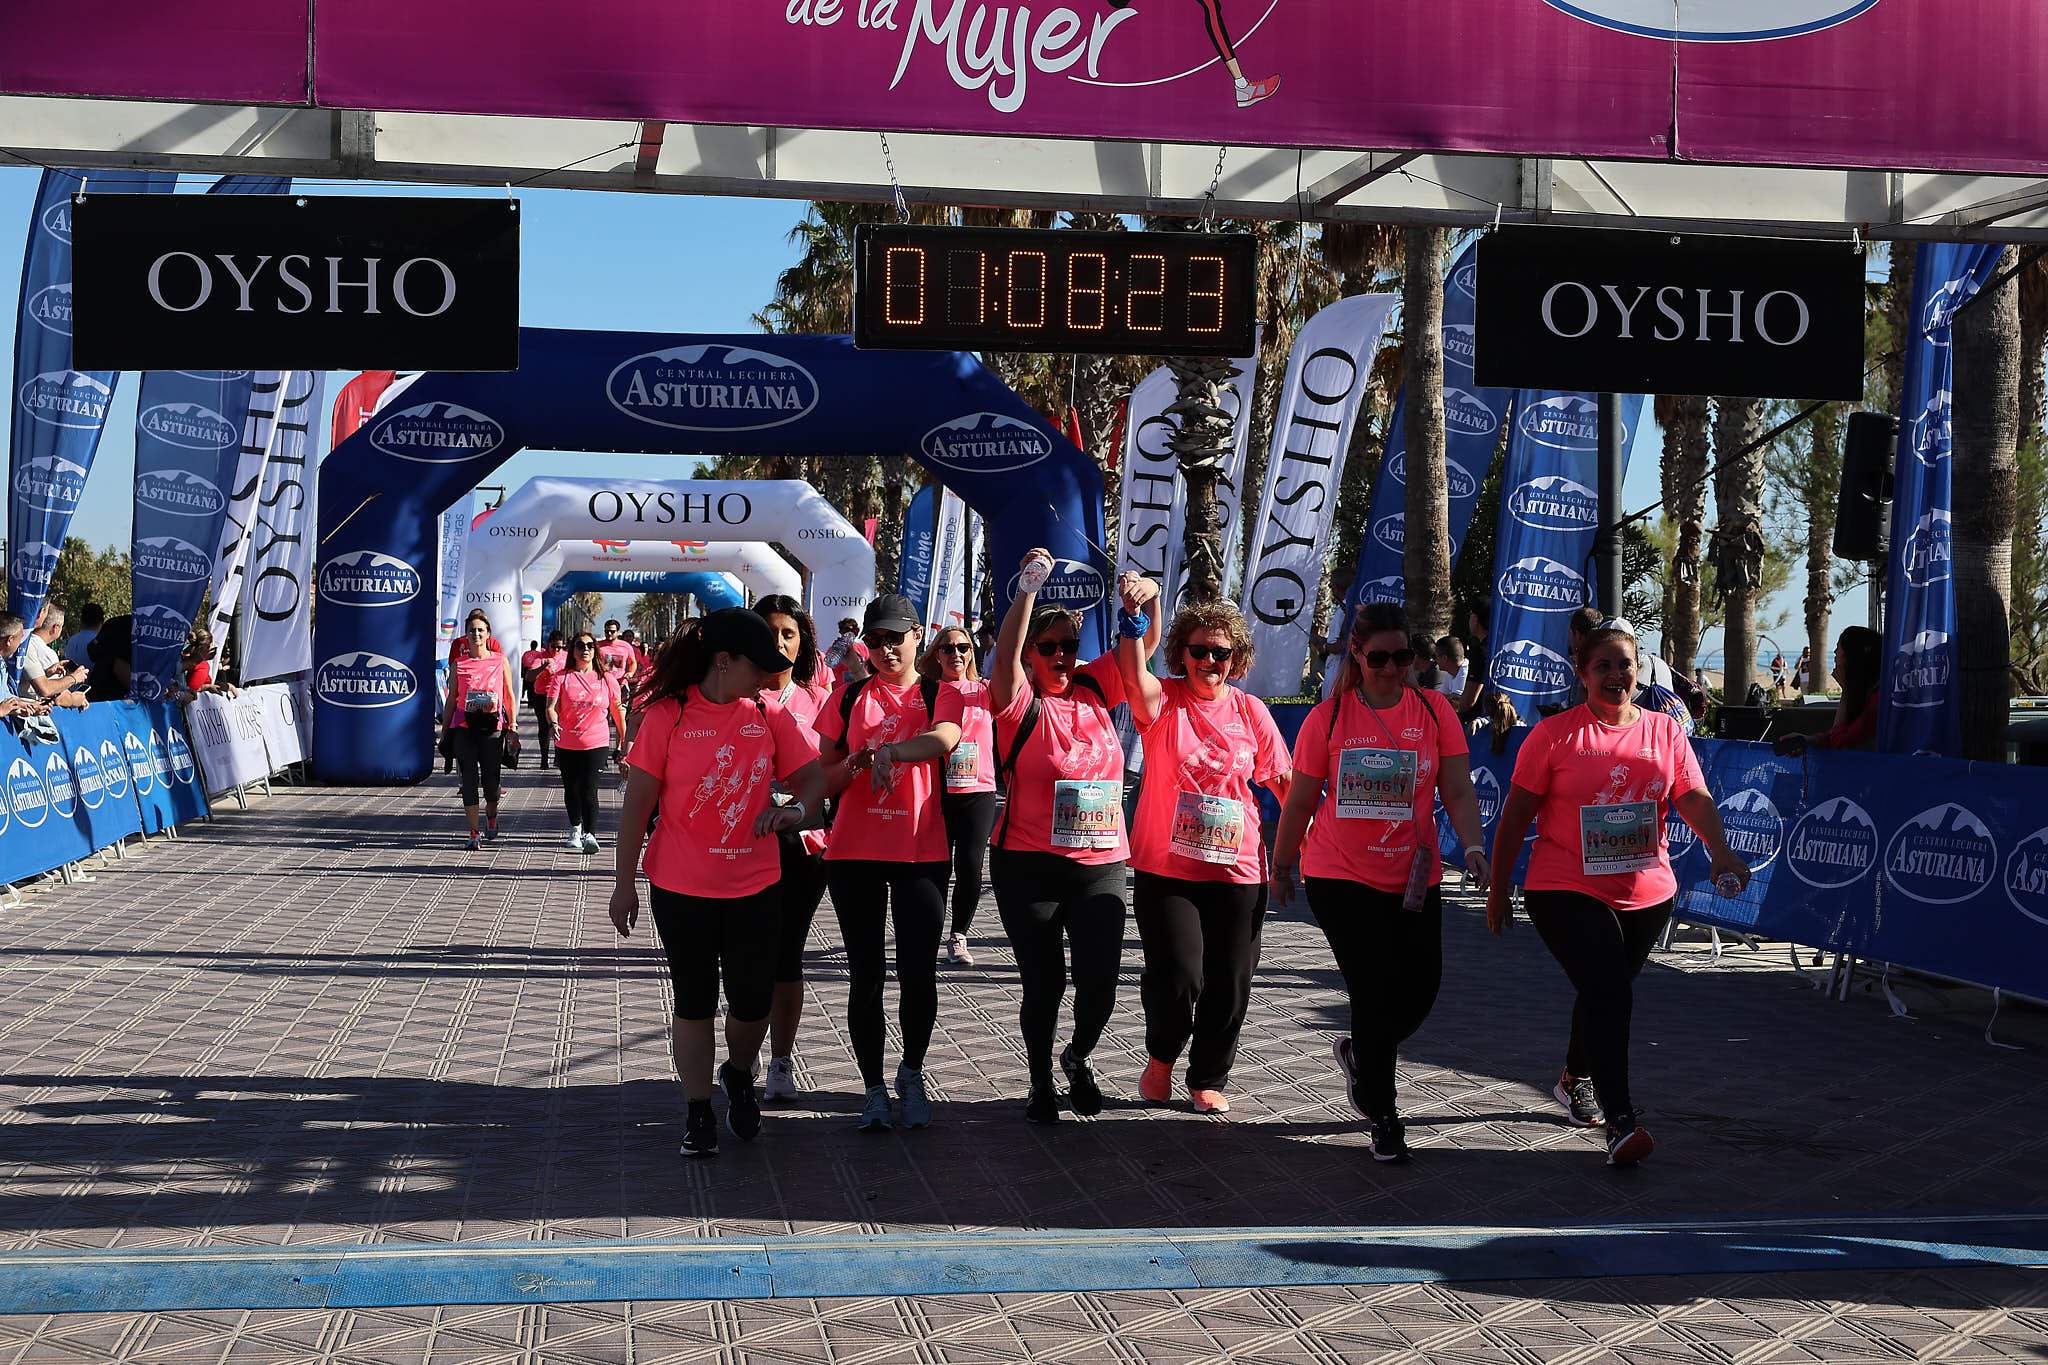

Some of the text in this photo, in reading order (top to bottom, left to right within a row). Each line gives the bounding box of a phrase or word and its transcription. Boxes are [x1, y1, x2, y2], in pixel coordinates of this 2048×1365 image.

[889, 0, 1138, 113] Mujer
[147, 251, 456, 316] OYSHO
[1542, 282, 1810, 346] OYSHO
[656, 369, 796, 380] CENTRAL LECHERA
[622, 369, 804, 410] ASTURIANA
[26, 385, 105, 418] ASTURIAN
[147, 413, 230, 444] ASTURIANA
[377, 424, 494, 448] ASTURIANA
[1526, 411, 1598, 439] ASTURIA
[931, 436, 1045, 458] ASTURIANA
[137, 480, 217, 510] ASTURIANA
[1251, 347, 1357, 626] OYSHO
[588, 491, 752, 525] OYSHO
[489, 526, 539, 538] OYSHO
[798, 528, 846, 540] OYSHO
[138, 555, 206, 577] STURIANA
[907, 531, 933, 603] Marlene
[323, 571, 414, 594] ASTURIANA
[466, 592, 512, 604] OYSHO
[822, 595, 868, 608] OYSHO
[320, 671, 411, 694] ASTURIANA
[684, 729, 717, 739] OYSHO
[1344, 736, 1377, 747] OYSHO
[1578, 749, 1611, 757] OYSHO
[1363, 779, 1391, 792] 016
[1079, 811, 1104, 822] 016
[1344, 807, 1370, 815] OYSHO
[1810, 827, 1871, 840] CENTRAL LECHERA
[1913, 835, 1988, 853] CENTRAL LECHERA
[1790, 826, 1868, 868] ASTURIANA
[1890, 836, 1985, 883] ASTURIANA
